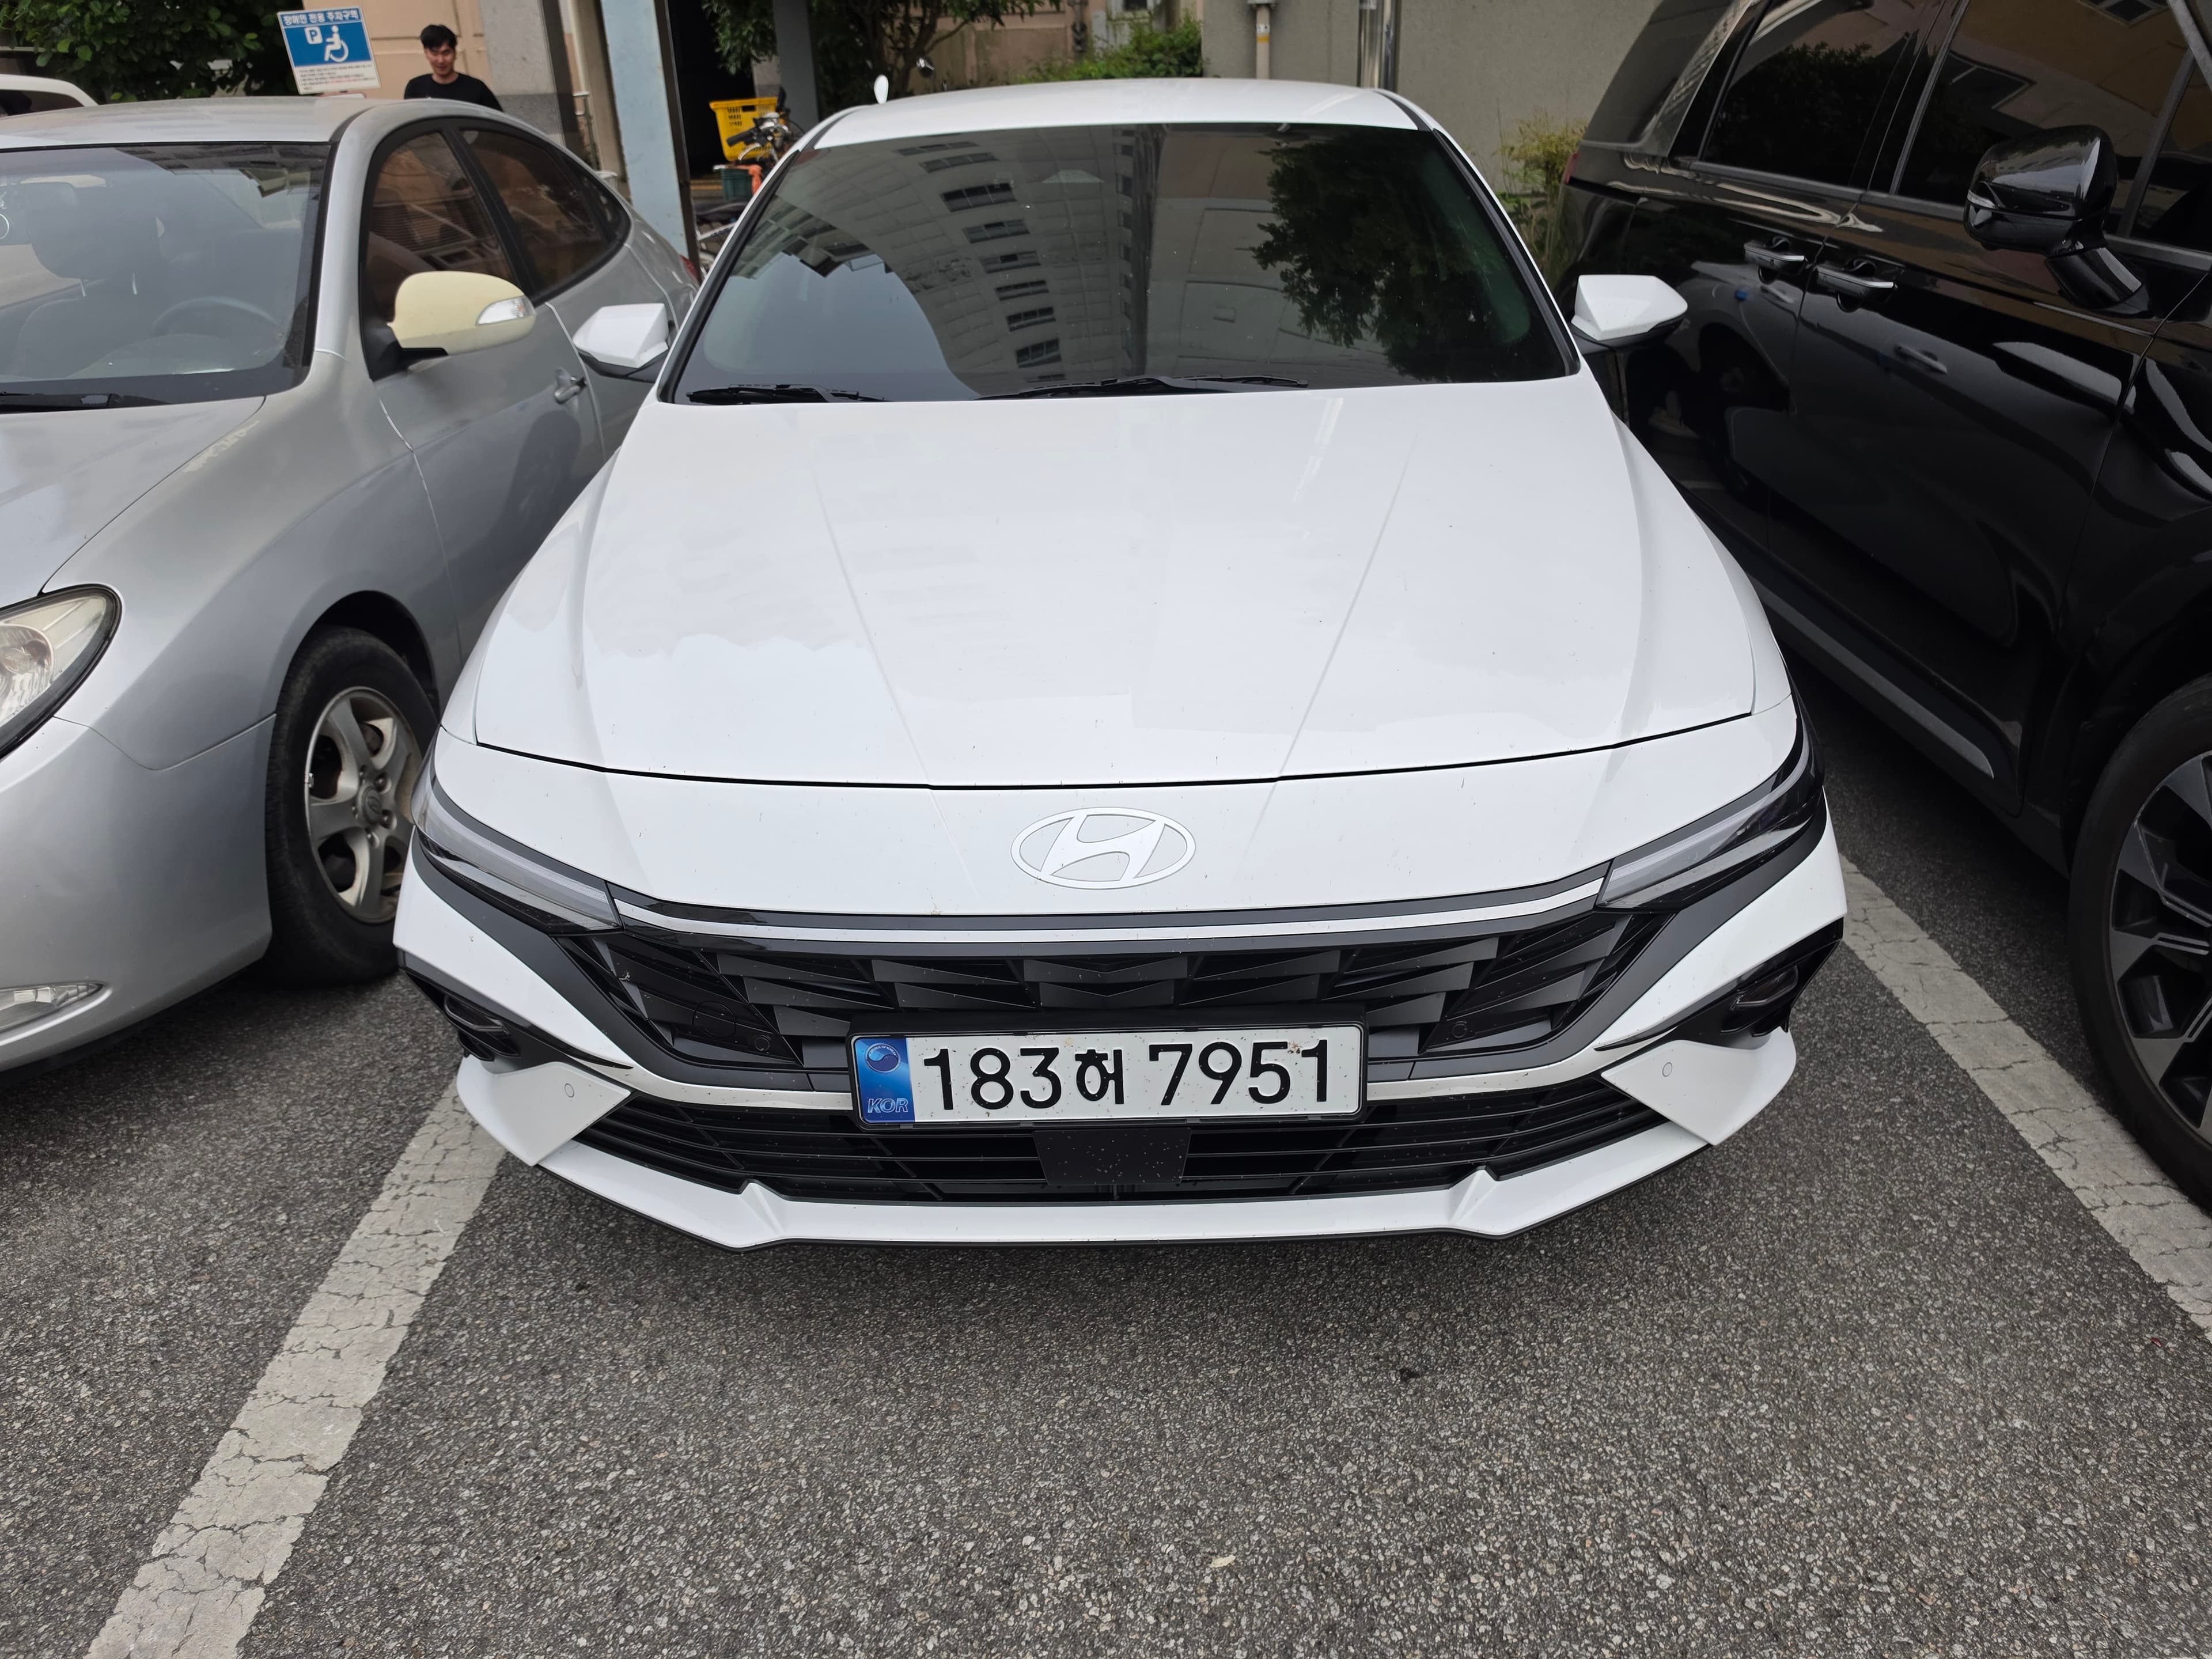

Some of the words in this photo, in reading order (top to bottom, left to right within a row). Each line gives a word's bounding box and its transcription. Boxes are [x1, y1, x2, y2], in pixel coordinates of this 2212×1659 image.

[283, 14, 307, 25] 장애인
[308, 13, 325, 23] 전용
[309, 29, 318, 42] P
[923, 1047, 1124, 1110] 183허
[1149, 1039, 1328, 1105] 7951
[868, 1098, 908, 1113] KOR
